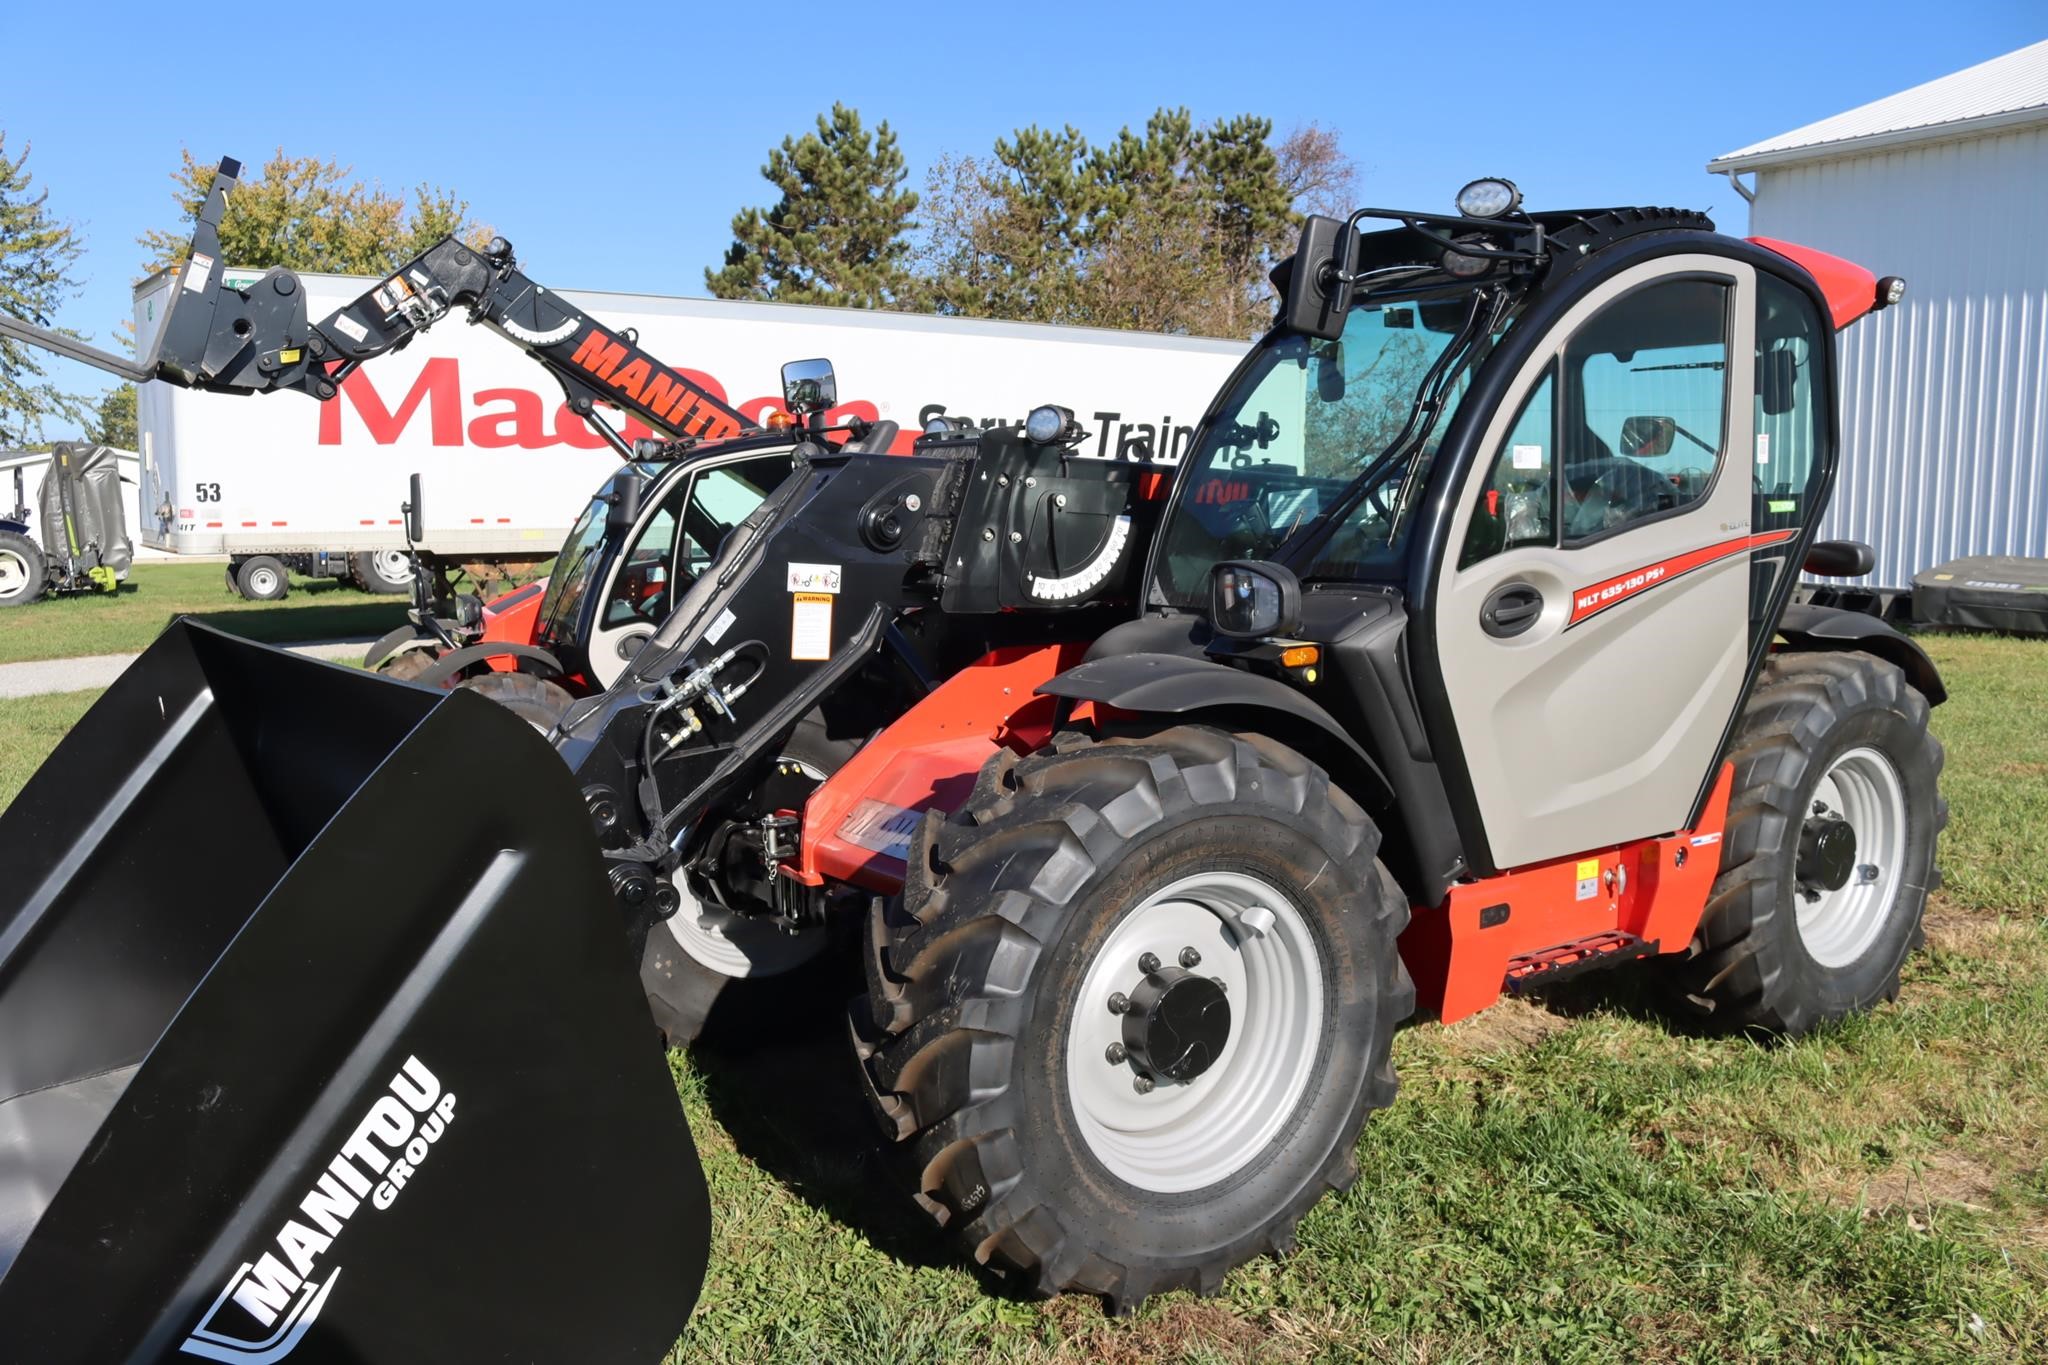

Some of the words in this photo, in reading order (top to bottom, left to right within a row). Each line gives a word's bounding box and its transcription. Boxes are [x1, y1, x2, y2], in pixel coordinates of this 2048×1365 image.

[570, 329, 756, 441] MANITO
[195, 482, 222, 503] 53
[803, 595, 831, 603] WARNING
[1577, 592, 1601, 610] MLT
[1601, 576, 1645, 601] 635-130
[372, 1092, 457, 1211] GROUP
[232, 1054, 441, 1328] MANITOU
